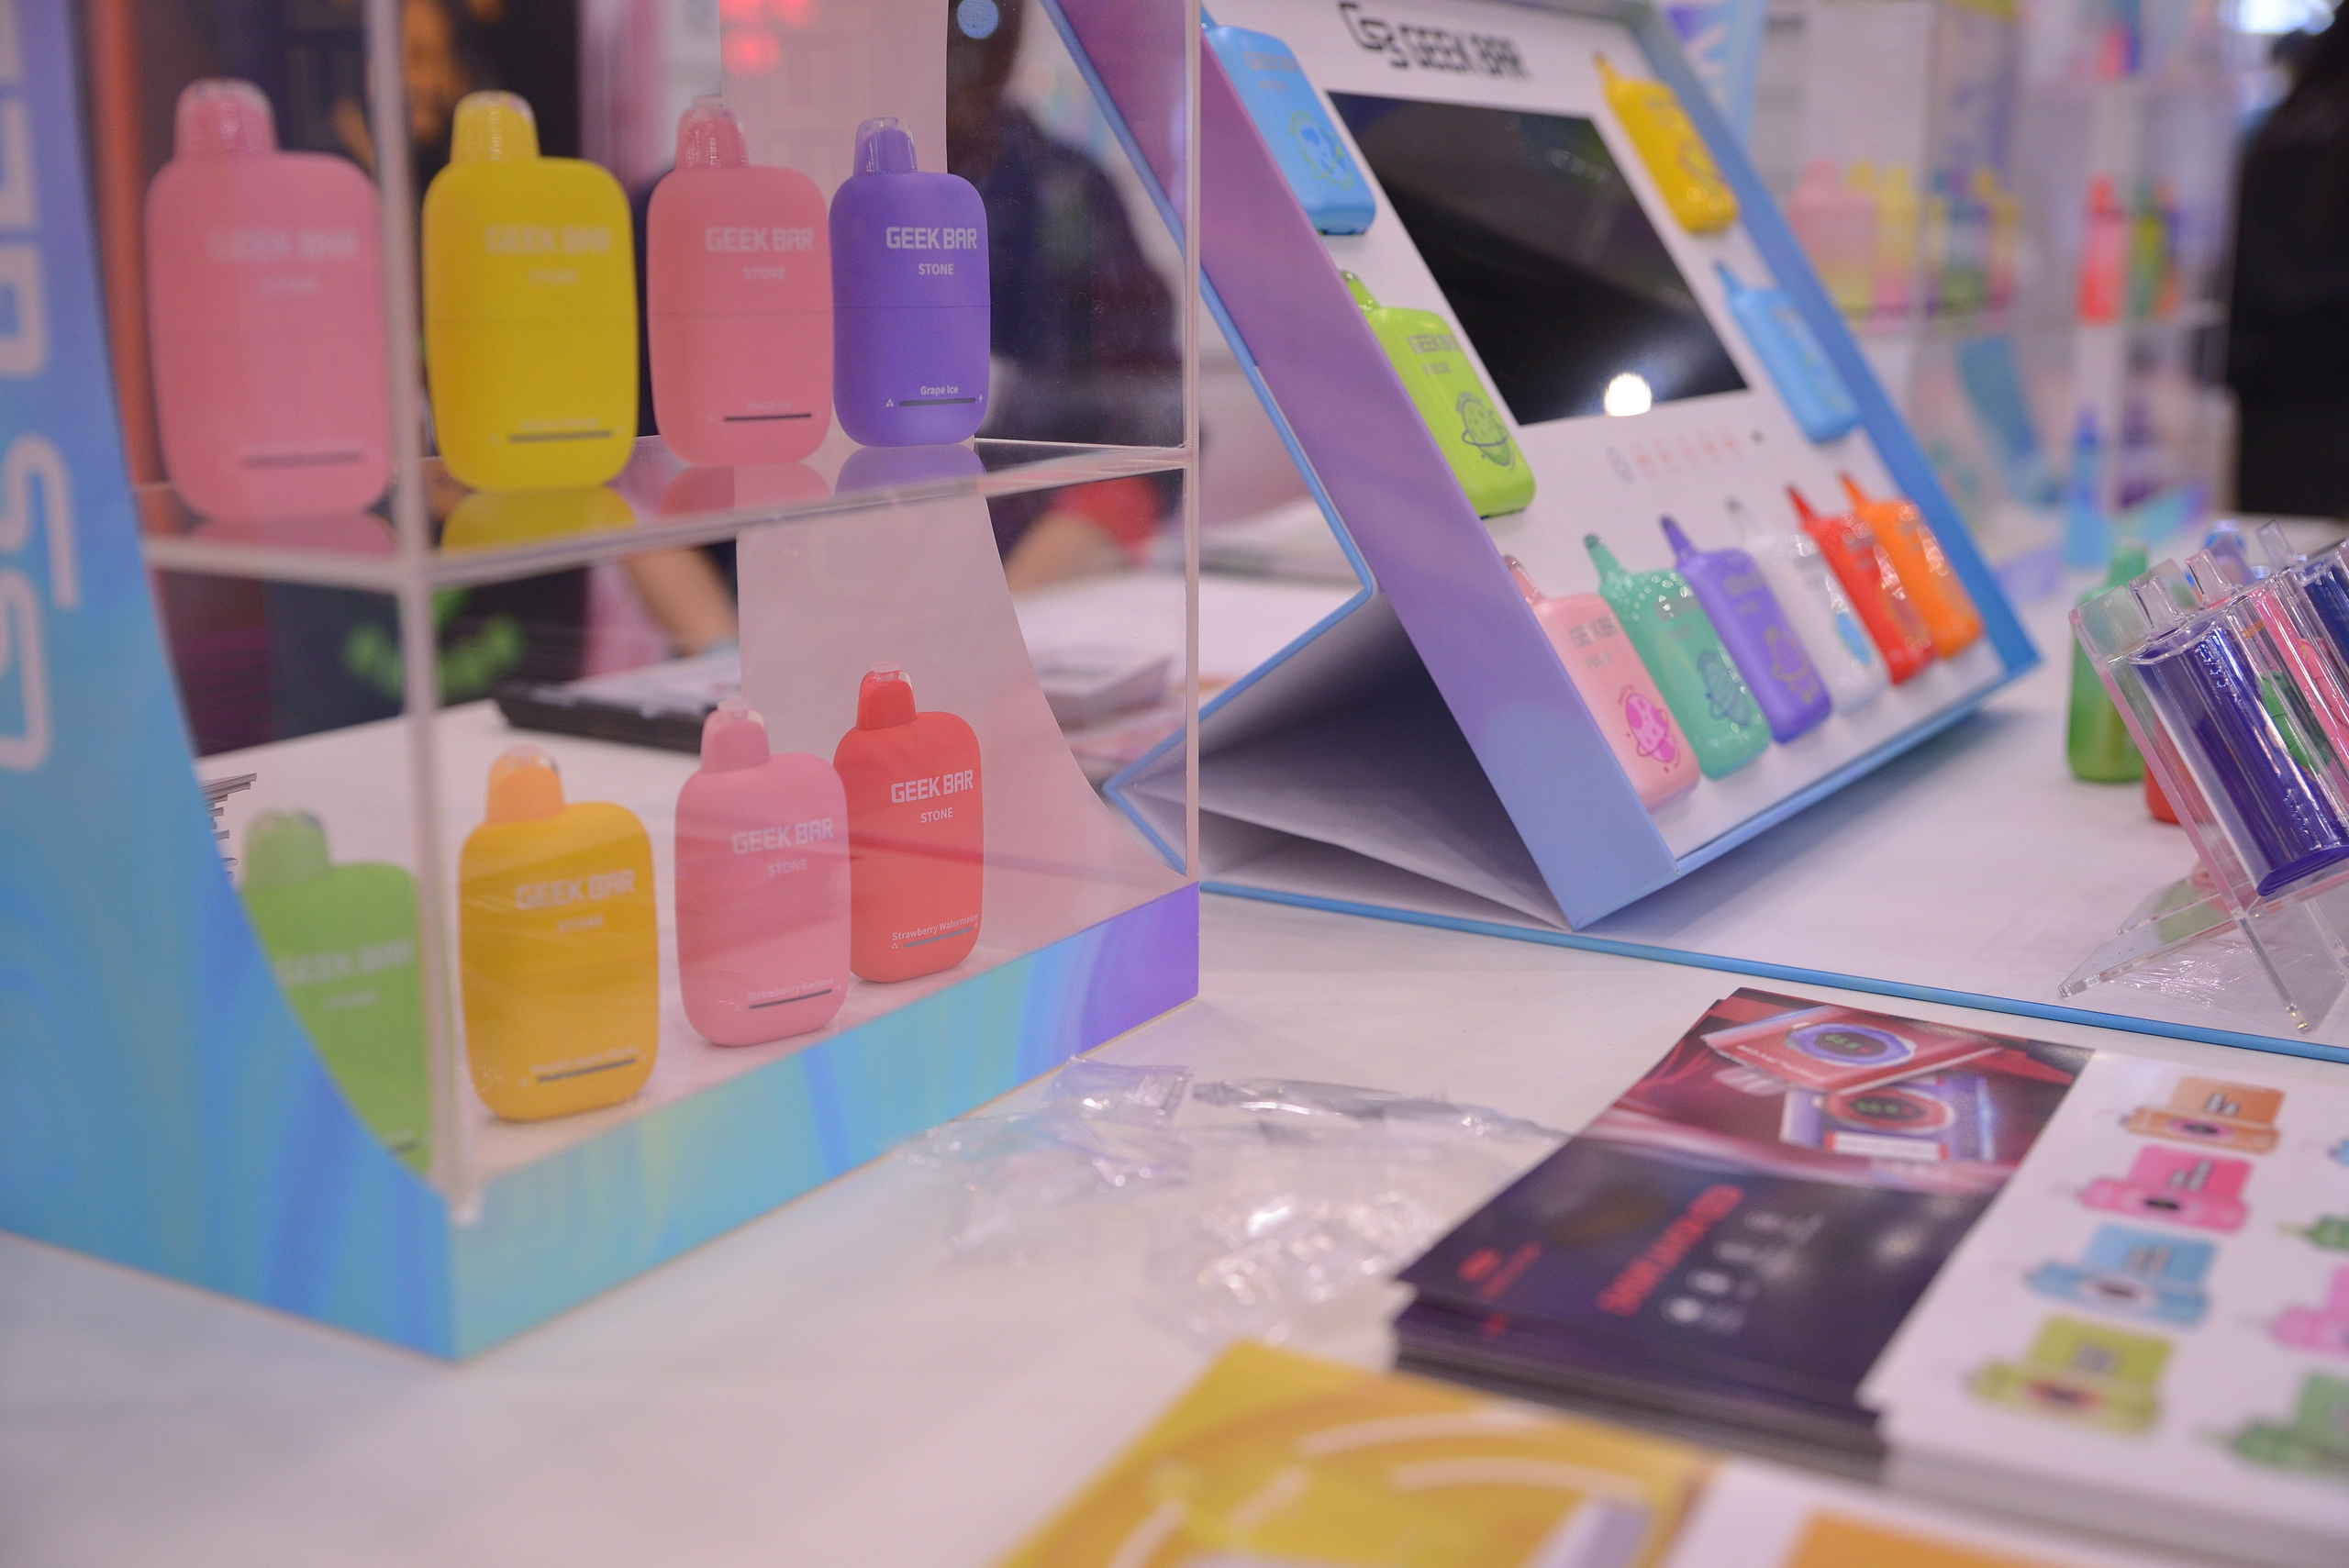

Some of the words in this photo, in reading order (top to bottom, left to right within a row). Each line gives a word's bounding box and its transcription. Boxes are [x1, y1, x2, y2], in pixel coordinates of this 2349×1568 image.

[705, 227, 769, 252] GEEK
[771, 228, 814, 251] BAR
[885, 226, 941, 250] GEEK
[942, 228, 978, 250] BAR
[743, 267, 785, 281] STONE
[918, 262, 954, 275] STONE
[920, 385, 945, 396] Grape
[946, 385, 959, 394] Ice
[890, 776, 941, 804] GEEK
[942, 769, 974, 795] BAR
[920, 807, 953, 824] STONE
[731, 826, 792, 855] GEEK
[794, 817, 834, 845] BAR
[767, 858, 807, 876] STONE
[515, 876, 584, 910] GEEK
[586, 868, 635, 900] BAR
[892, 925, 939, 941] Strawberry
[939, 913, 979, 931] Watermelon
